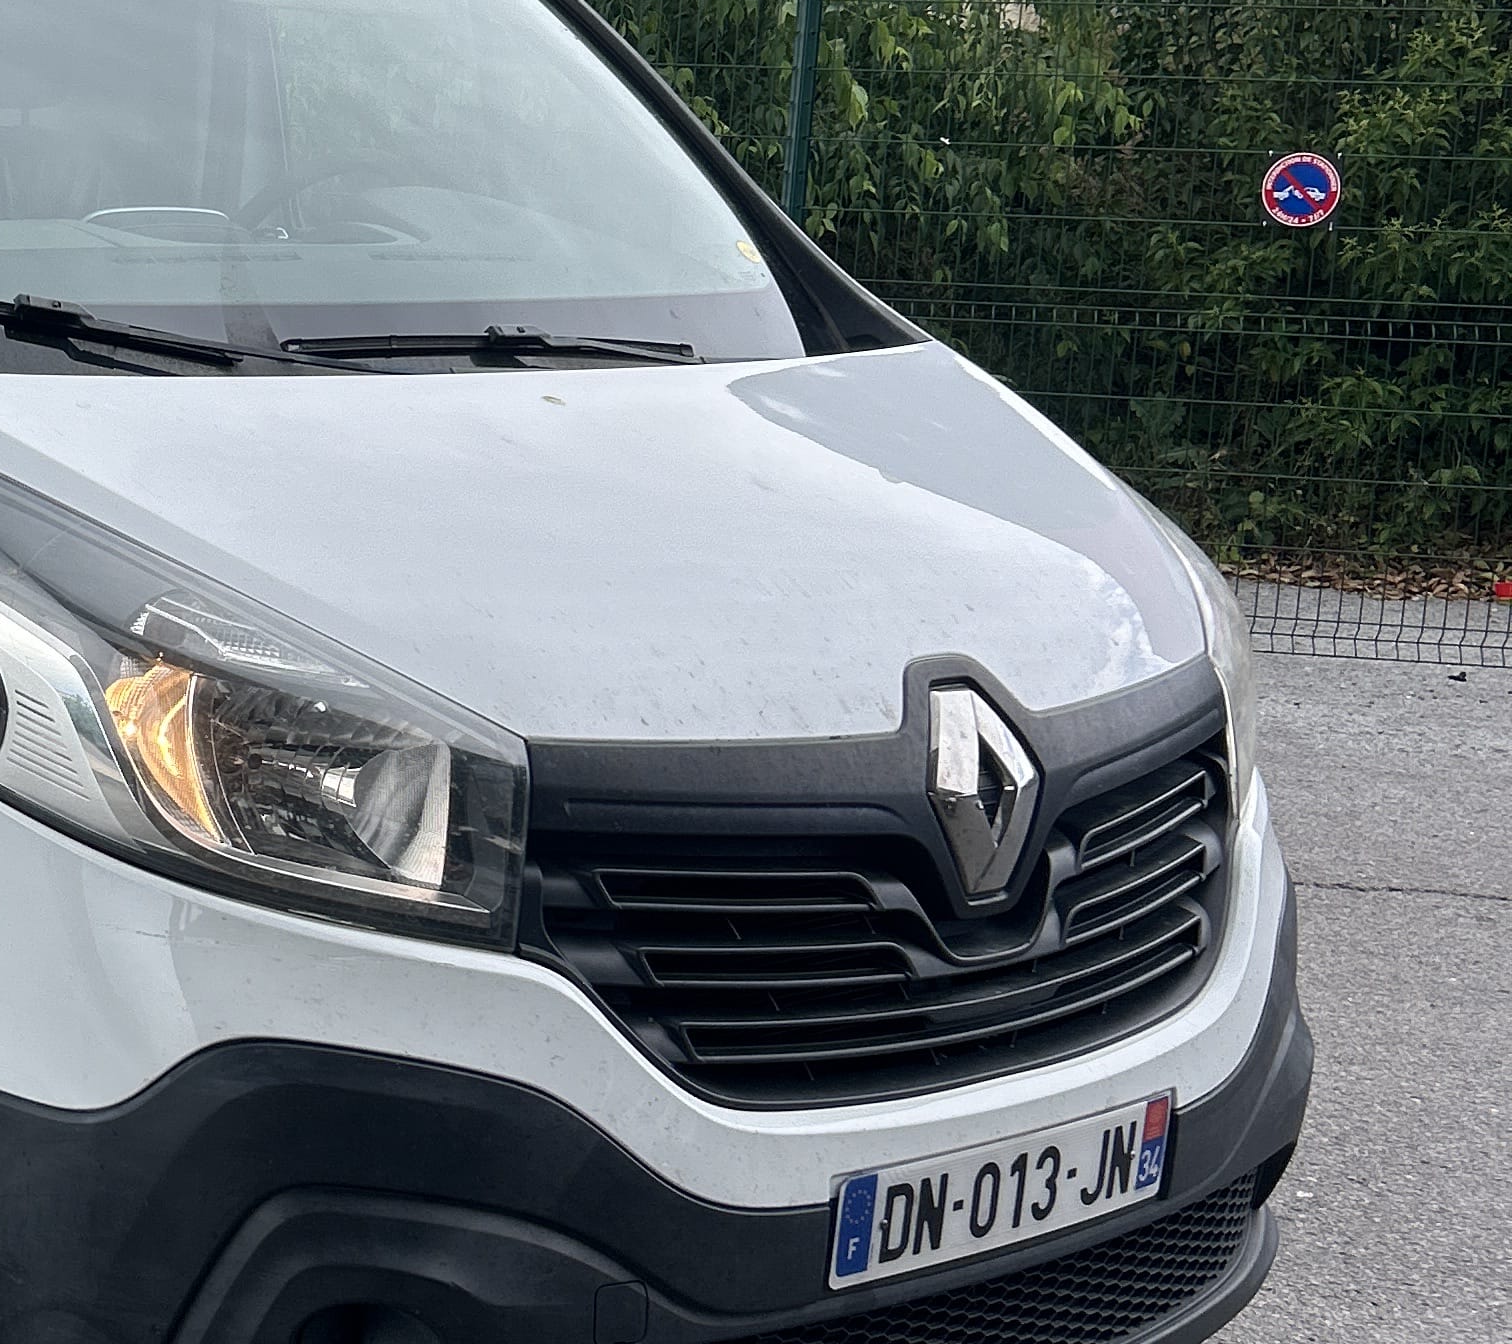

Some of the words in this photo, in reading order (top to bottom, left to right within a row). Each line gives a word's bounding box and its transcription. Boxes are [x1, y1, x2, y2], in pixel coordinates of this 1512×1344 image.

[1138, 1145, 1161, 1182] 34
[878, 1120, 1137, 1264] DN-013-JN
[846, 1236, 861, 1261] F
